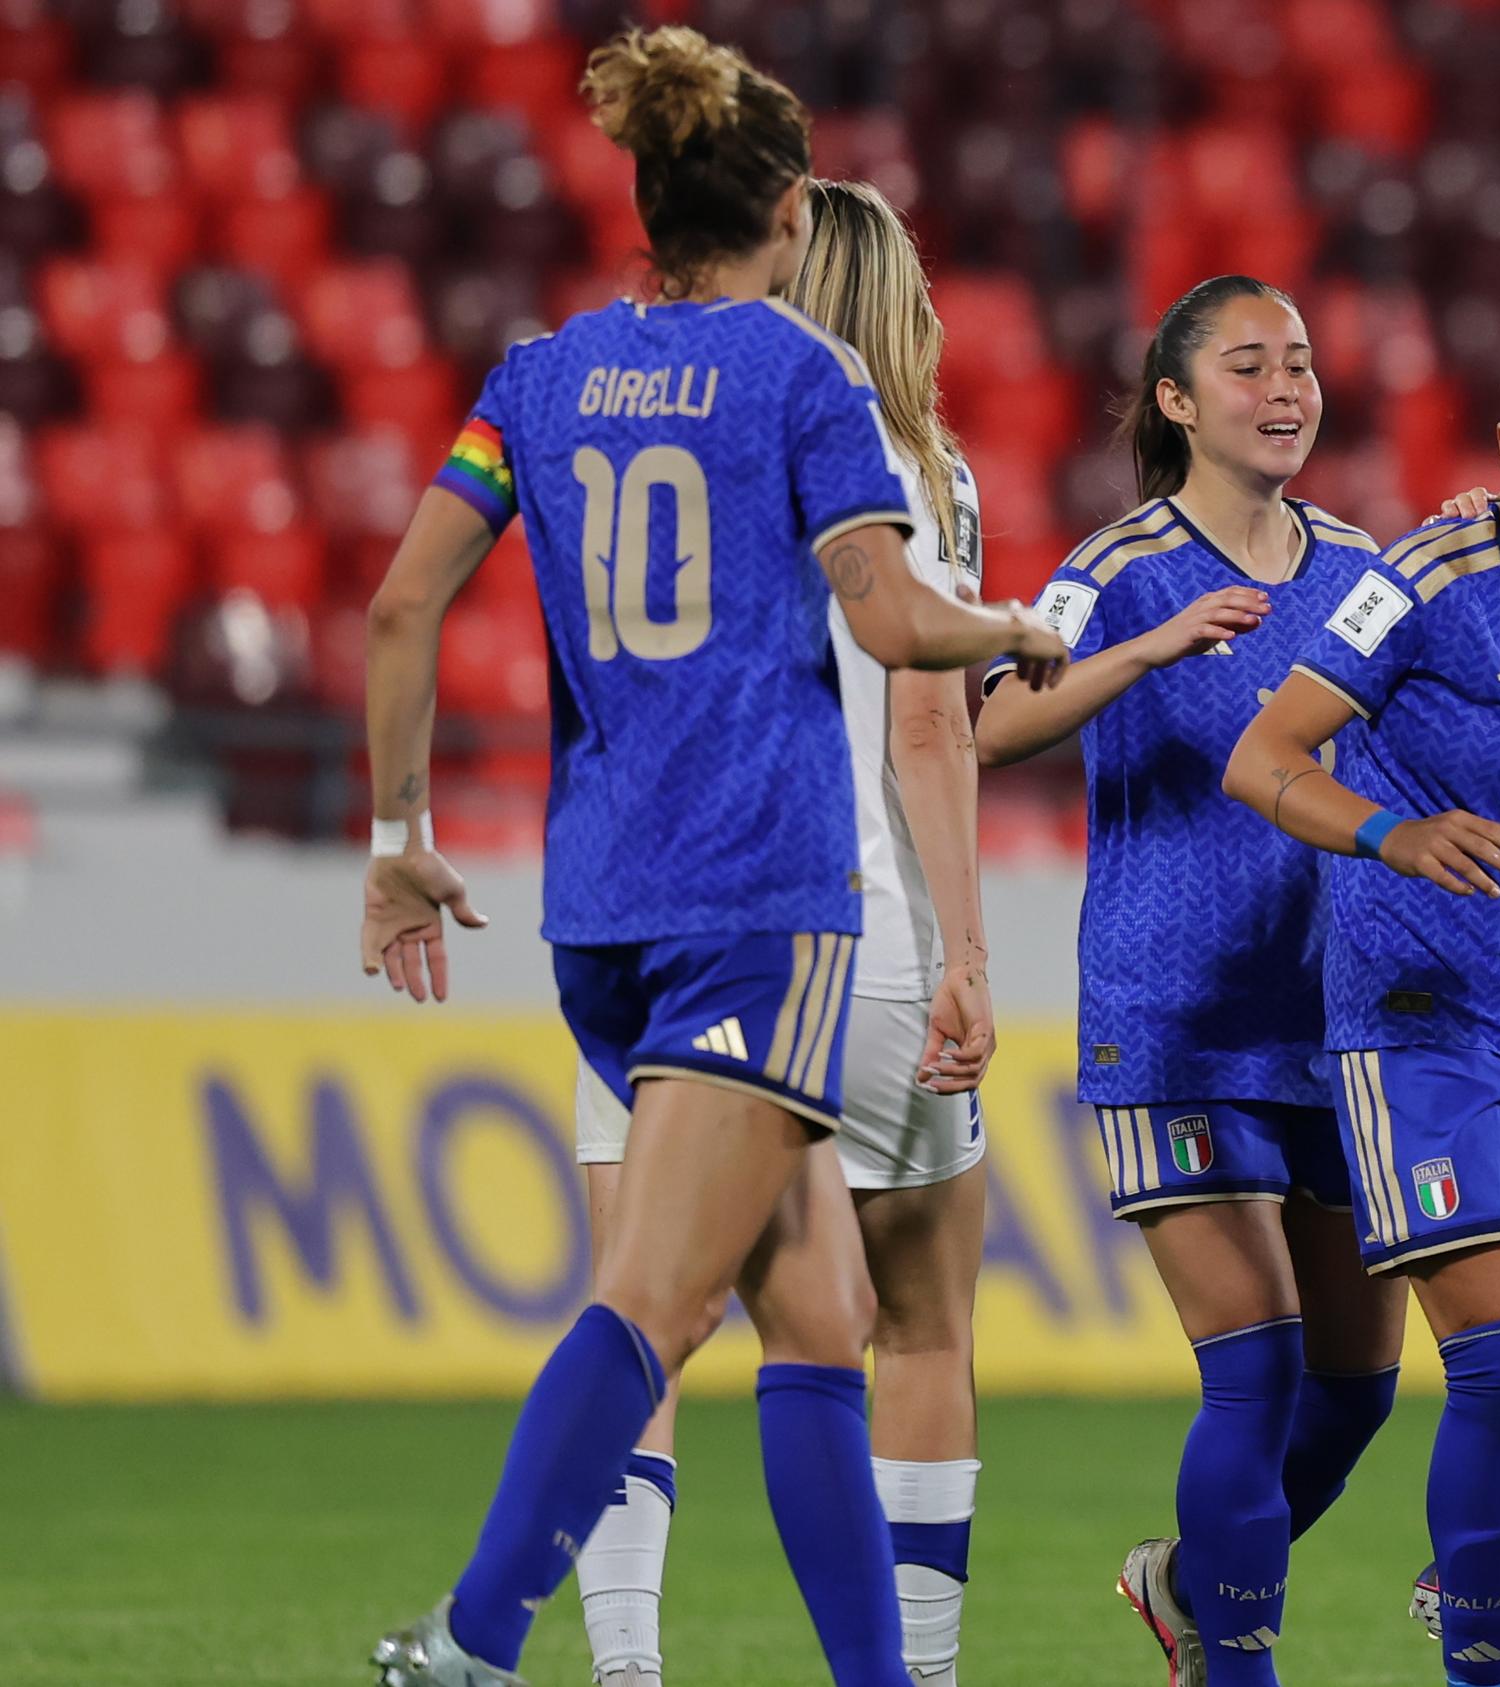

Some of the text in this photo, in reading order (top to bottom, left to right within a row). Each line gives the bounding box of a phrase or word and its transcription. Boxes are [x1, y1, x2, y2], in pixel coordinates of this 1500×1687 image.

[578, 365, 720, 419] GIRELLI
[572, 445, 713, 661] 10
[1171, 1119, 1205, 1136] ITALIA
[1415, 1161, 1451, 1181] ITALIA
